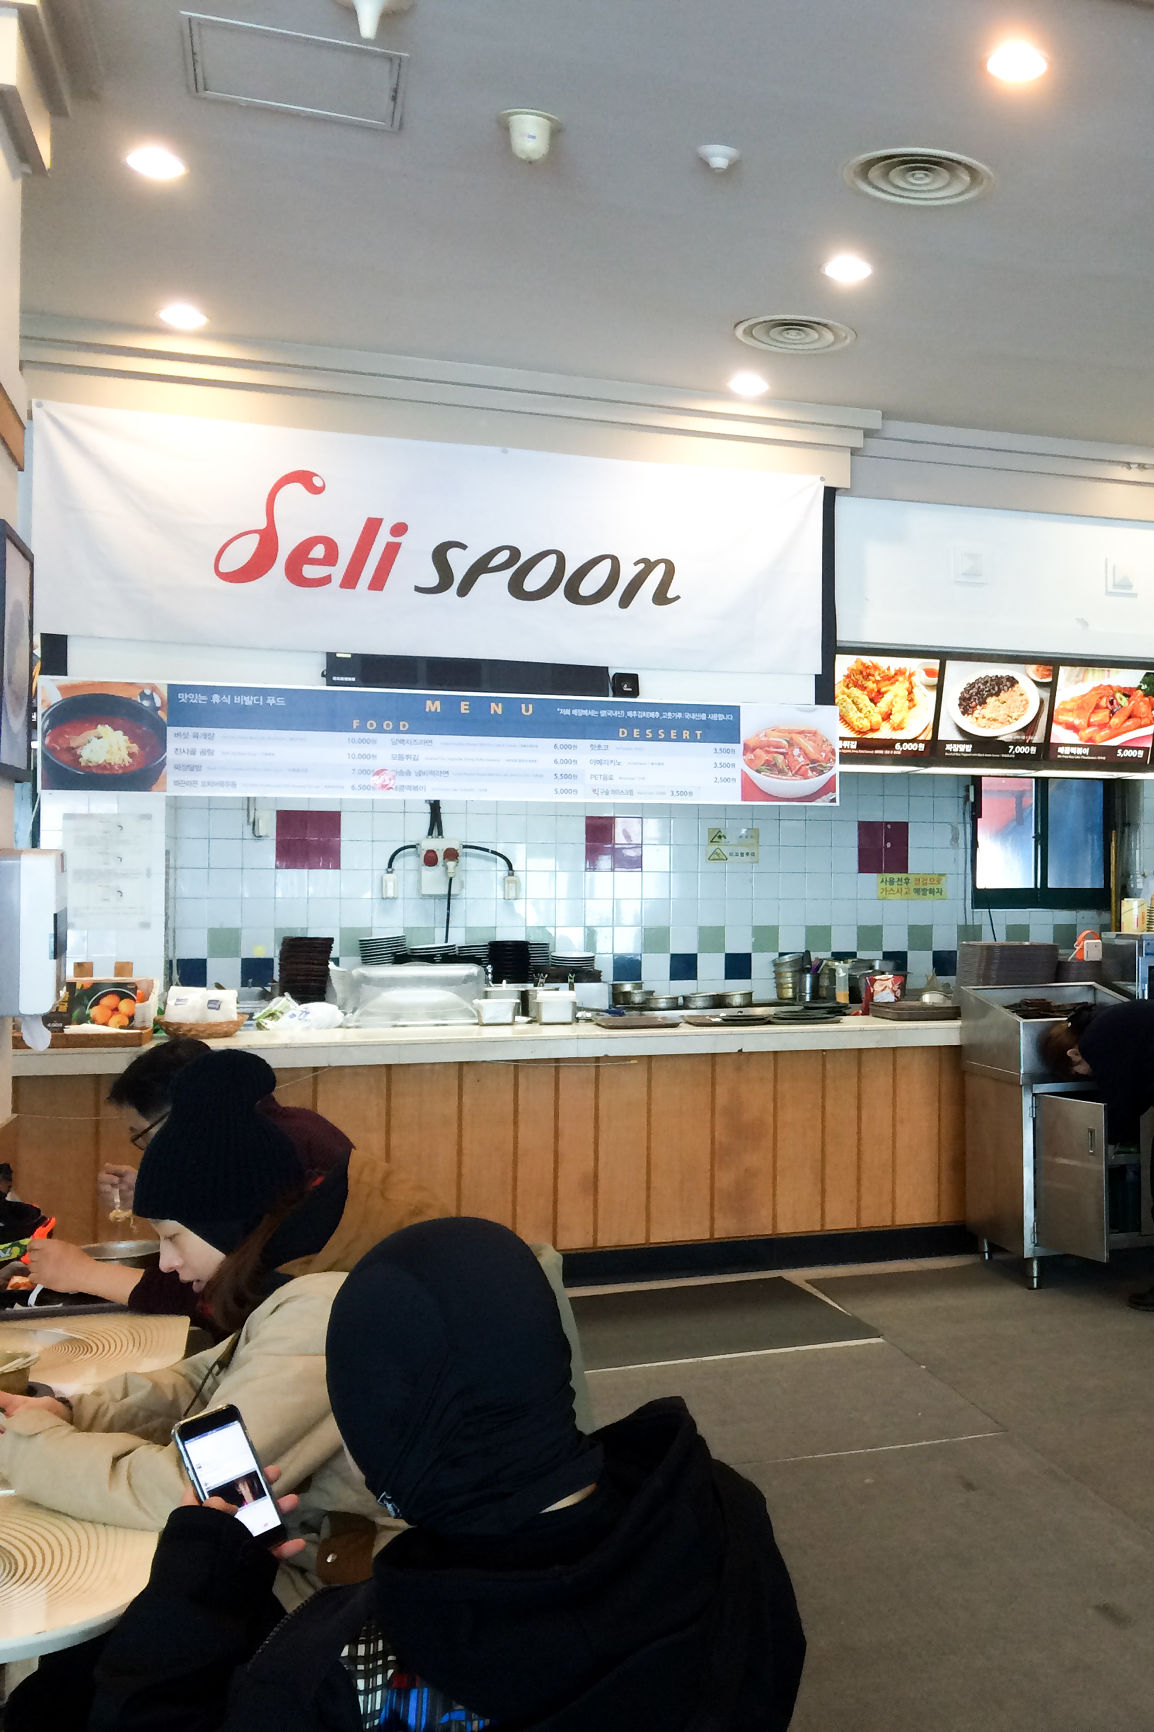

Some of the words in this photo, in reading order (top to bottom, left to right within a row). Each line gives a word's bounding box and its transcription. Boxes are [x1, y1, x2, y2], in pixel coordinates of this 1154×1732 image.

[178, 692, 208, 704] 맛있는
[211, 693, 231, 705] 휴식
[234, 695, 263, 706] 비발디
[266, 696, 286, 706] 푸드
[425, 700, 533, 716] MENU
[352, 719, 409, 731] FOOD
[618, 728, 703, 740] DESSERT
[895, 742, 926, 751] 6,000원
[1008, 745, 1037, 754] 7,000원
[1116, 749, 1144, 758] 5,000원
